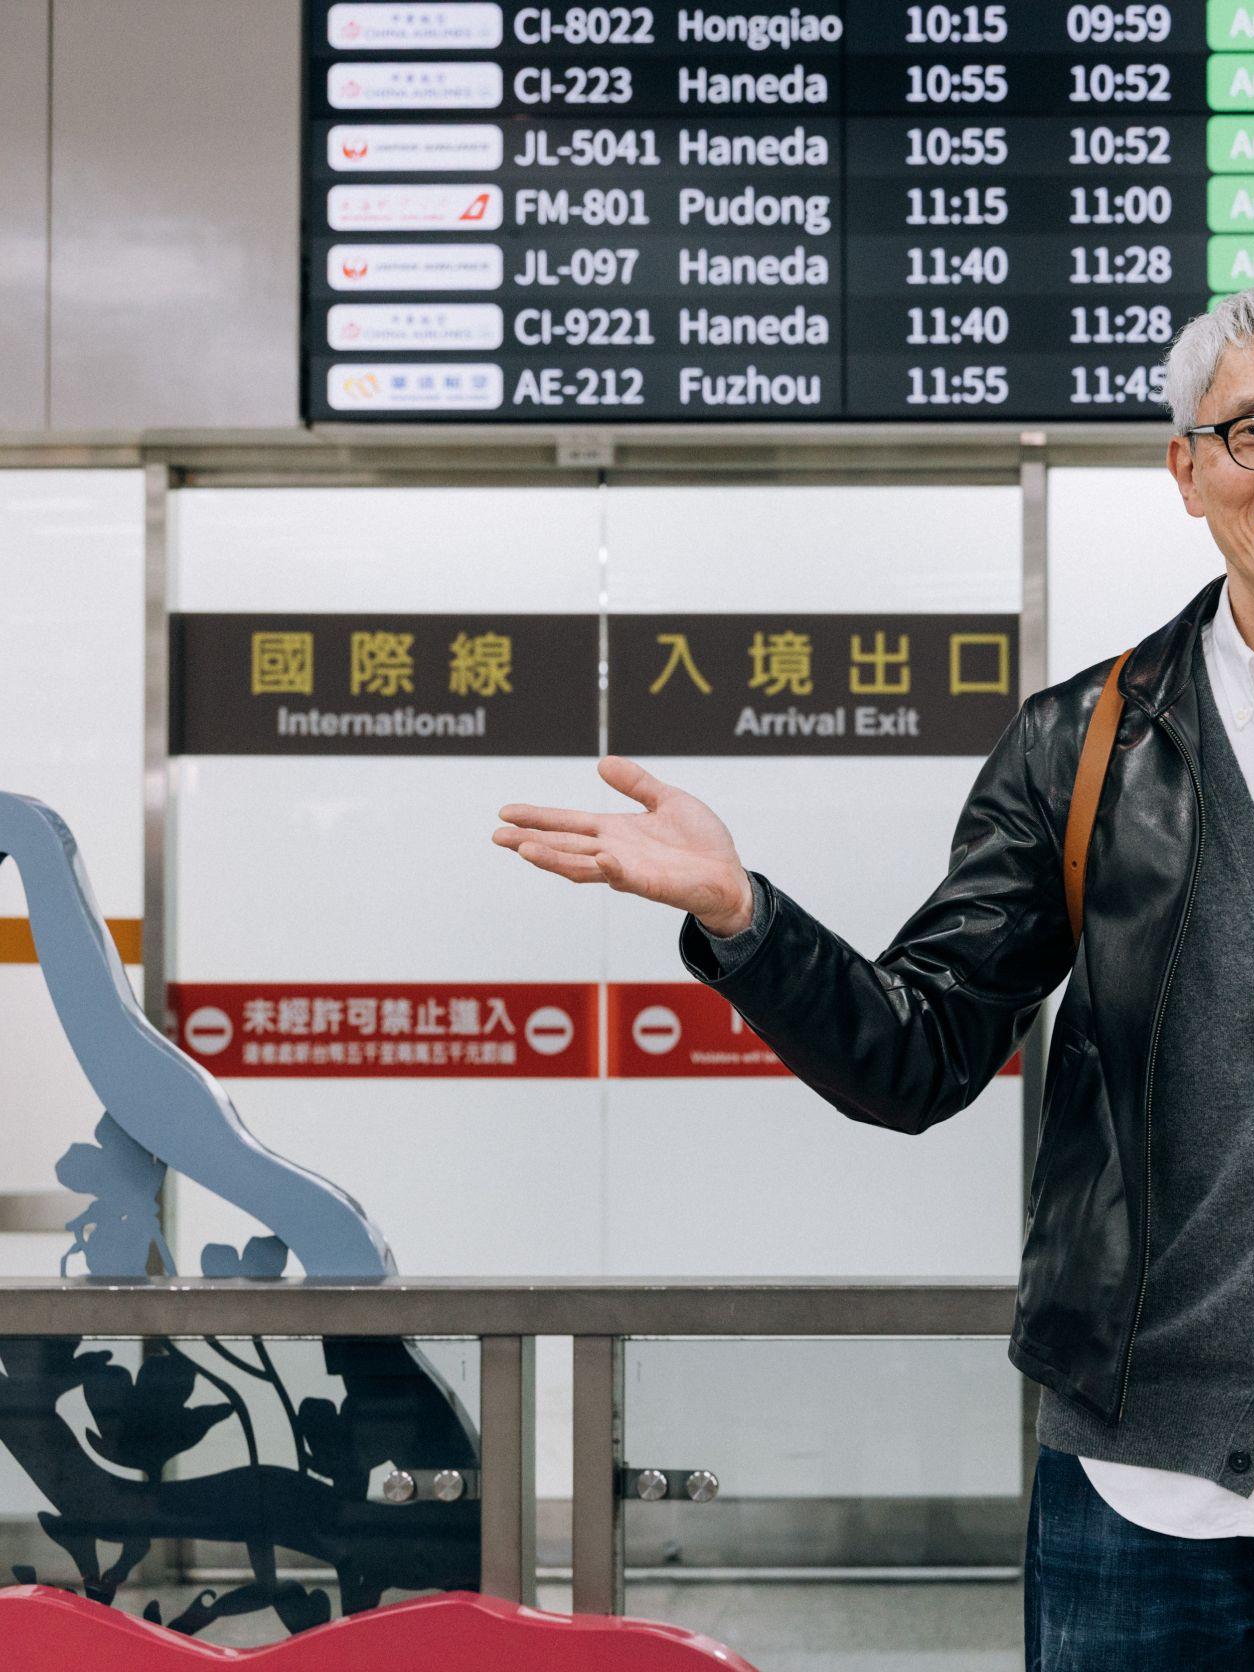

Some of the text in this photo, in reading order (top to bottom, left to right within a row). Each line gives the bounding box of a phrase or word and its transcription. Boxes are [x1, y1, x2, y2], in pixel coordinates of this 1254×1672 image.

[514, 7, 654, 44] CI-8022
[678, 8, 843, 50] Hongqiao
[906, 5, 1007, 42] 10:15
[1067, 5, 1171, 42] 09:59
[514, 67, 632, 104] CI-223
[679, 64, 827, 103] Haneda
[906, 65, 1008, 102] 10:55
[1069, 64, 1171, 101] 10:52
[514, 129, 660, 166] JL-5041
[679, 126, 828, 166] Haneda
[906, 128, 1007, 165] 10:55
[1069, 127, 1171, 164] 10:52
[516, 189, 649, 225] FM-801
[679, 186, 831, 235] Pudong
[906, 187, 1008, 224] 11:15
[1070, 186, 1171, 224] 11:00
[514, 249, 639, 285] JL-097
[679, 246, 828, 285] Haneda
[906, 247, 1008, 284] 11:40
[1070, 246, 1172, 283] 11:28
[514, 306, 1172, 345] CI-9221 Haneda 11:40 11:28
[513, 368, 644, 404] AE-212
[680, 365, 820, 405] Fuzhou
[907, 367, 1008, 404] 11:55
[1070, 366, 1168, 403] 11:45
[251, 632, 512, 696] 國際線
[650, 631, 1008, 695] 入境出口
[278, 707, 485, 736] International
[735, 707, 918, 736] Arrival Exit
[244, 998, 514, 1035] 未經許可禁止進入
